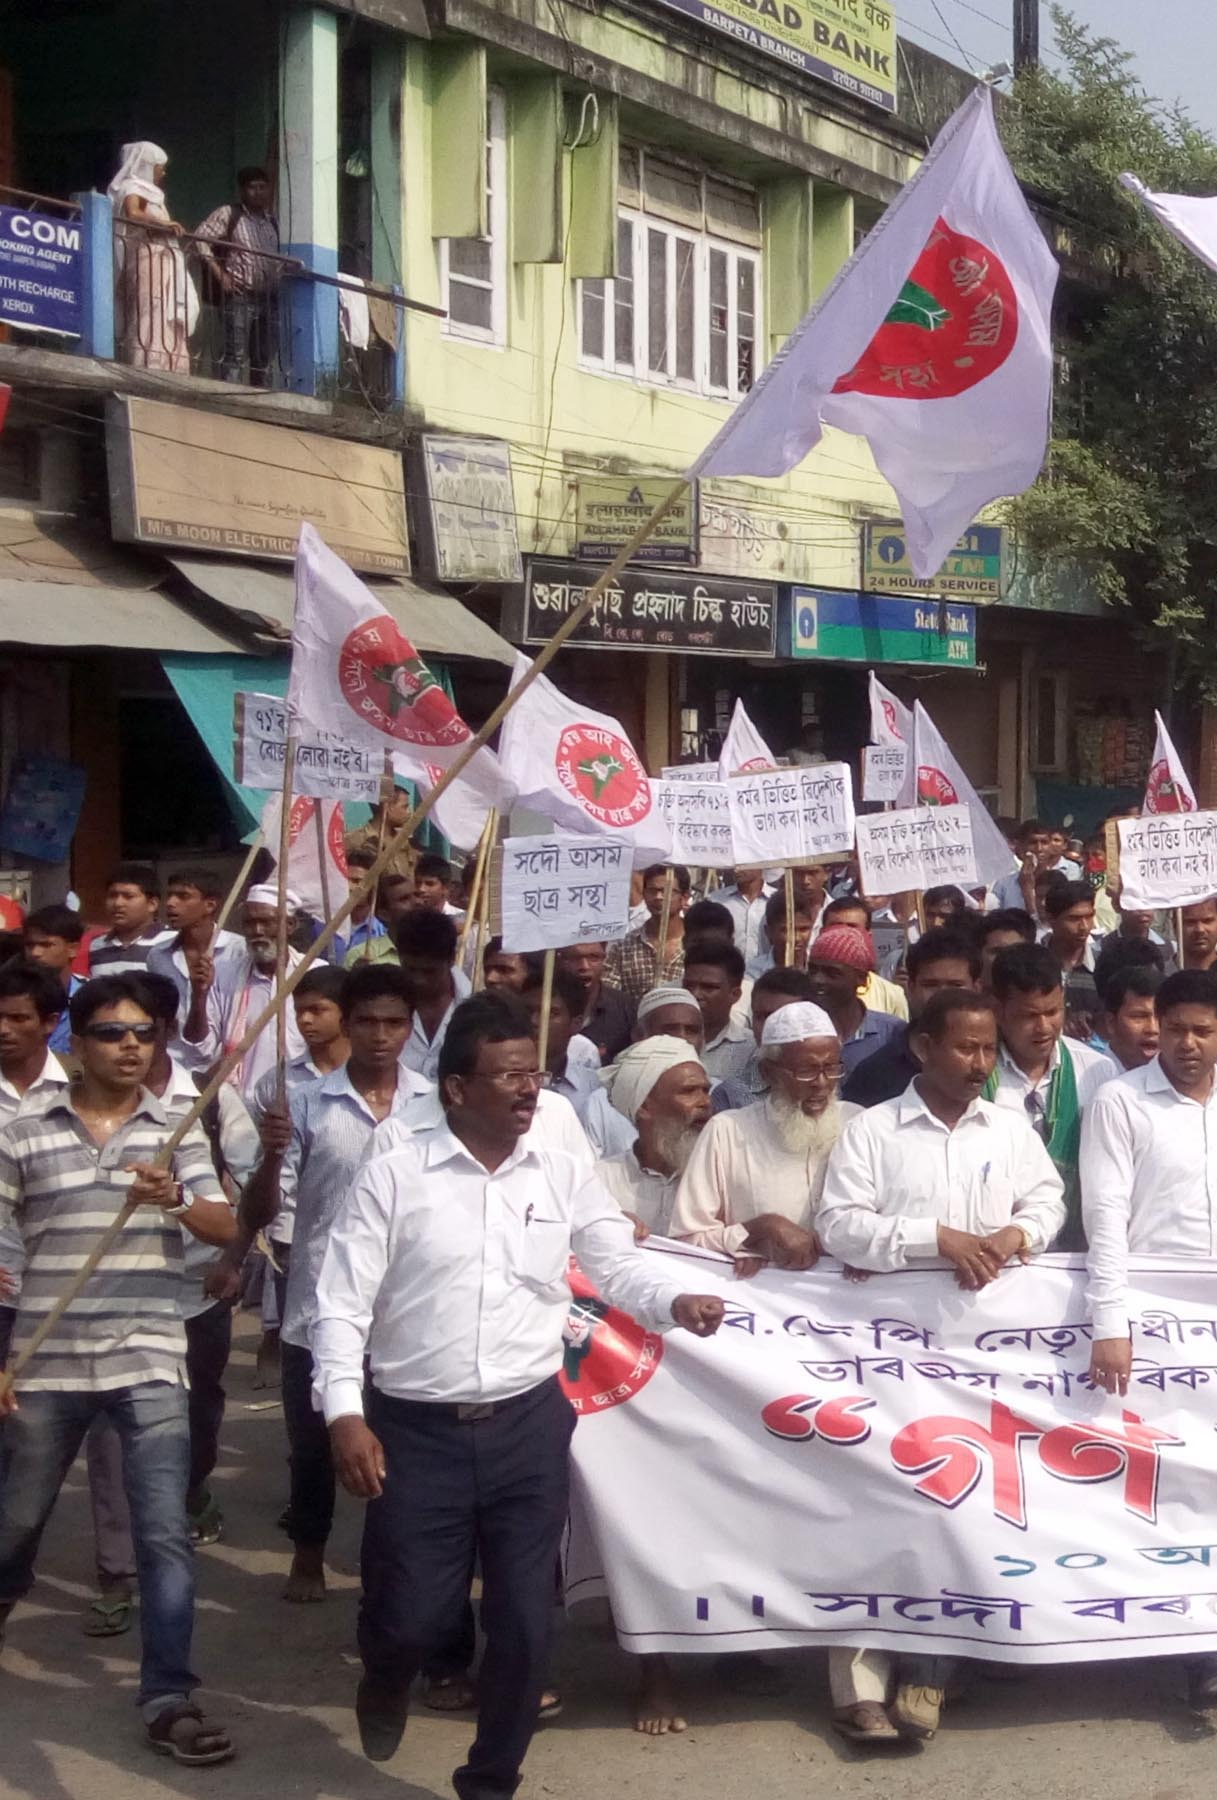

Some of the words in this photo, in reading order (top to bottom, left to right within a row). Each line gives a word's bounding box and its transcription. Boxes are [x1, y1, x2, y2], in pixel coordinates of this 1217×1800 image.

[703, 7, 758, 44] BARPETA
[760, 35, 806, 67] BRANCH
[813, 18, 891, 77] BANK
[10, 214, 80, 251] COM
[37, 248, 73, 264] AGENT
[18, 279, 76, 304] RECHARGE
[2, 297, 35, 315] XEROX
[177, 522, 221, 543] MOON
[585, 524, 641, 536] ALLAHAB
[375, 555, 404, 569] TOWN
[947, 557, 985, 574] TM
[869, 576, 886, 588] 24
[889, 576, 935, 590] HOURS
[940, 578, 998, 592] SERVICE
[947, 640, 969, 660] ATM
[513, 844, 560, 875] সদৌ
[567, 845, 622, 869] অসম
[994, 1550, 1108, 1577] ১০
[802, 1586, 1040, 1632] সদৌ
